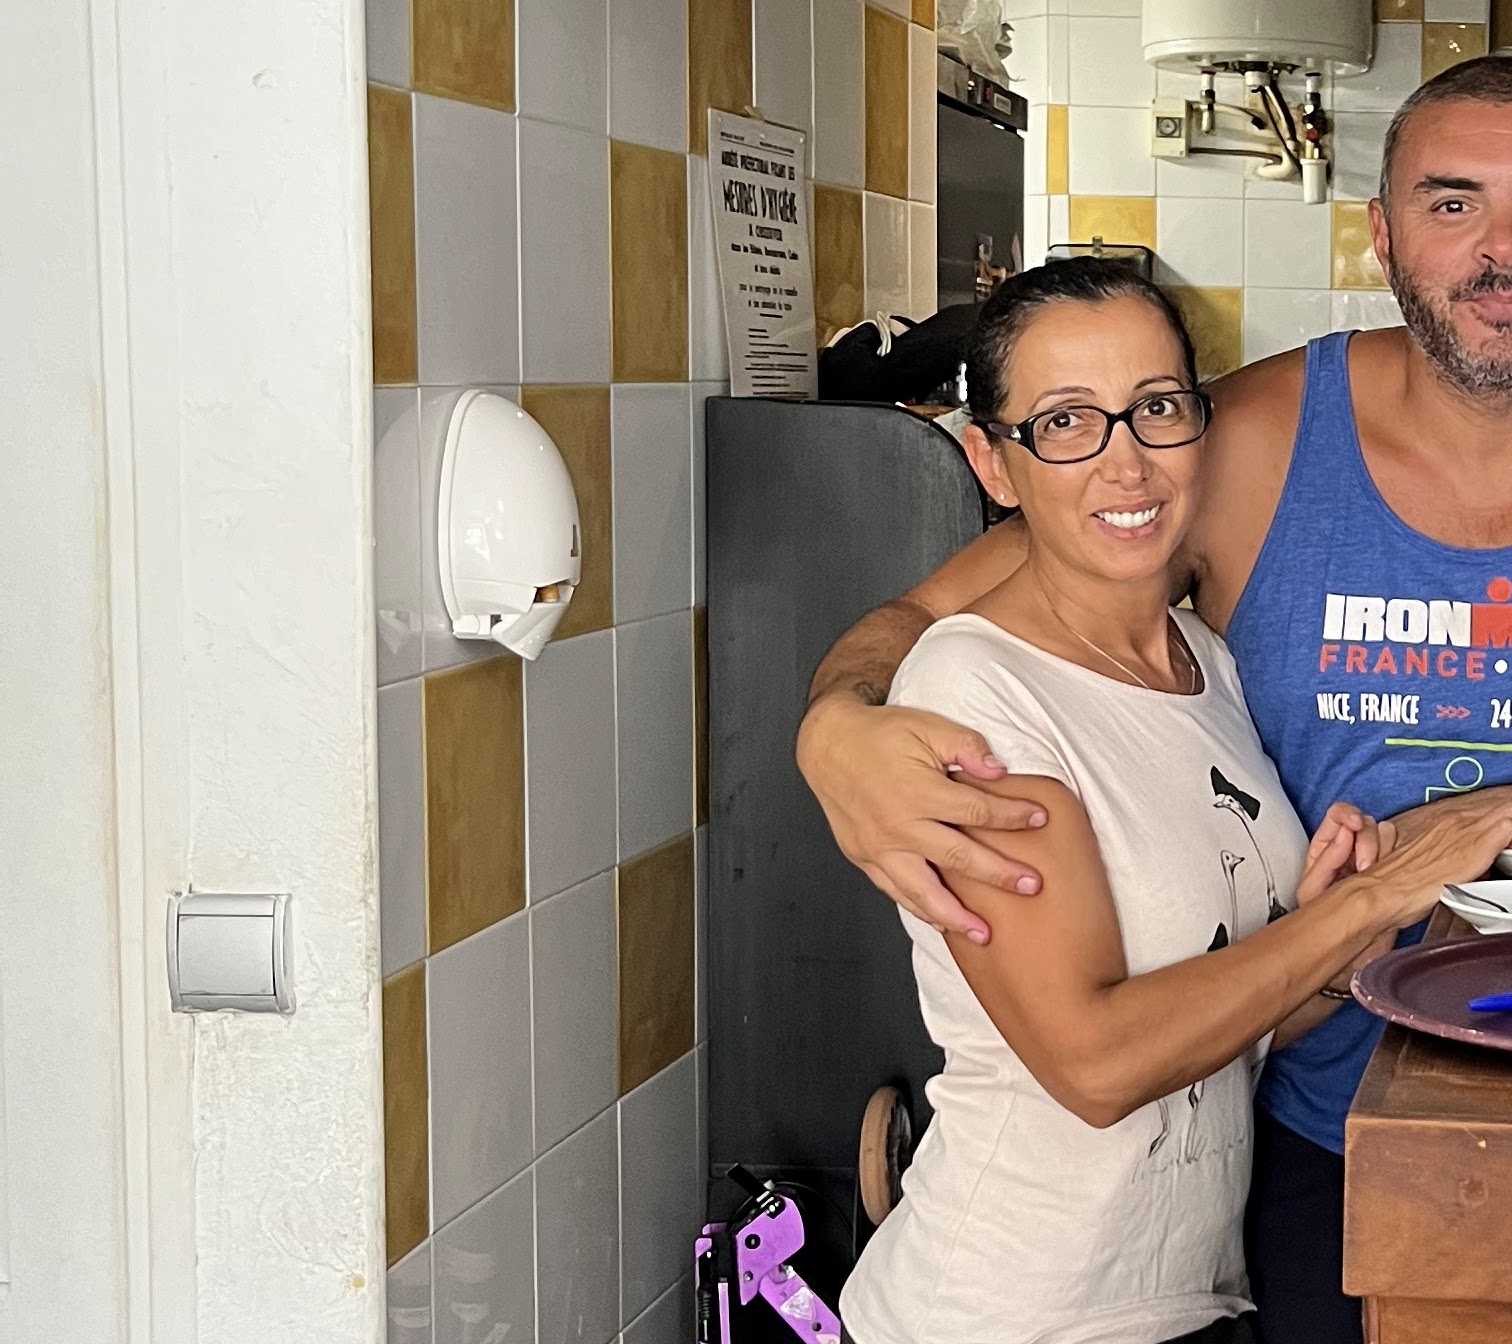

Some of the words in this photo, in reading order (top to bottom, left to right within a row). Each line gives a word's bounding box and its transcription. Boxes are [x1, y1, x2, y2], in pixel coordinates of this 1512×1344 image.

[1318, 644, 1487, 681] FRANCE
[1316, 692, 1356, 724] NICE,
[1360, 693, 1420, 725] FRANCE
